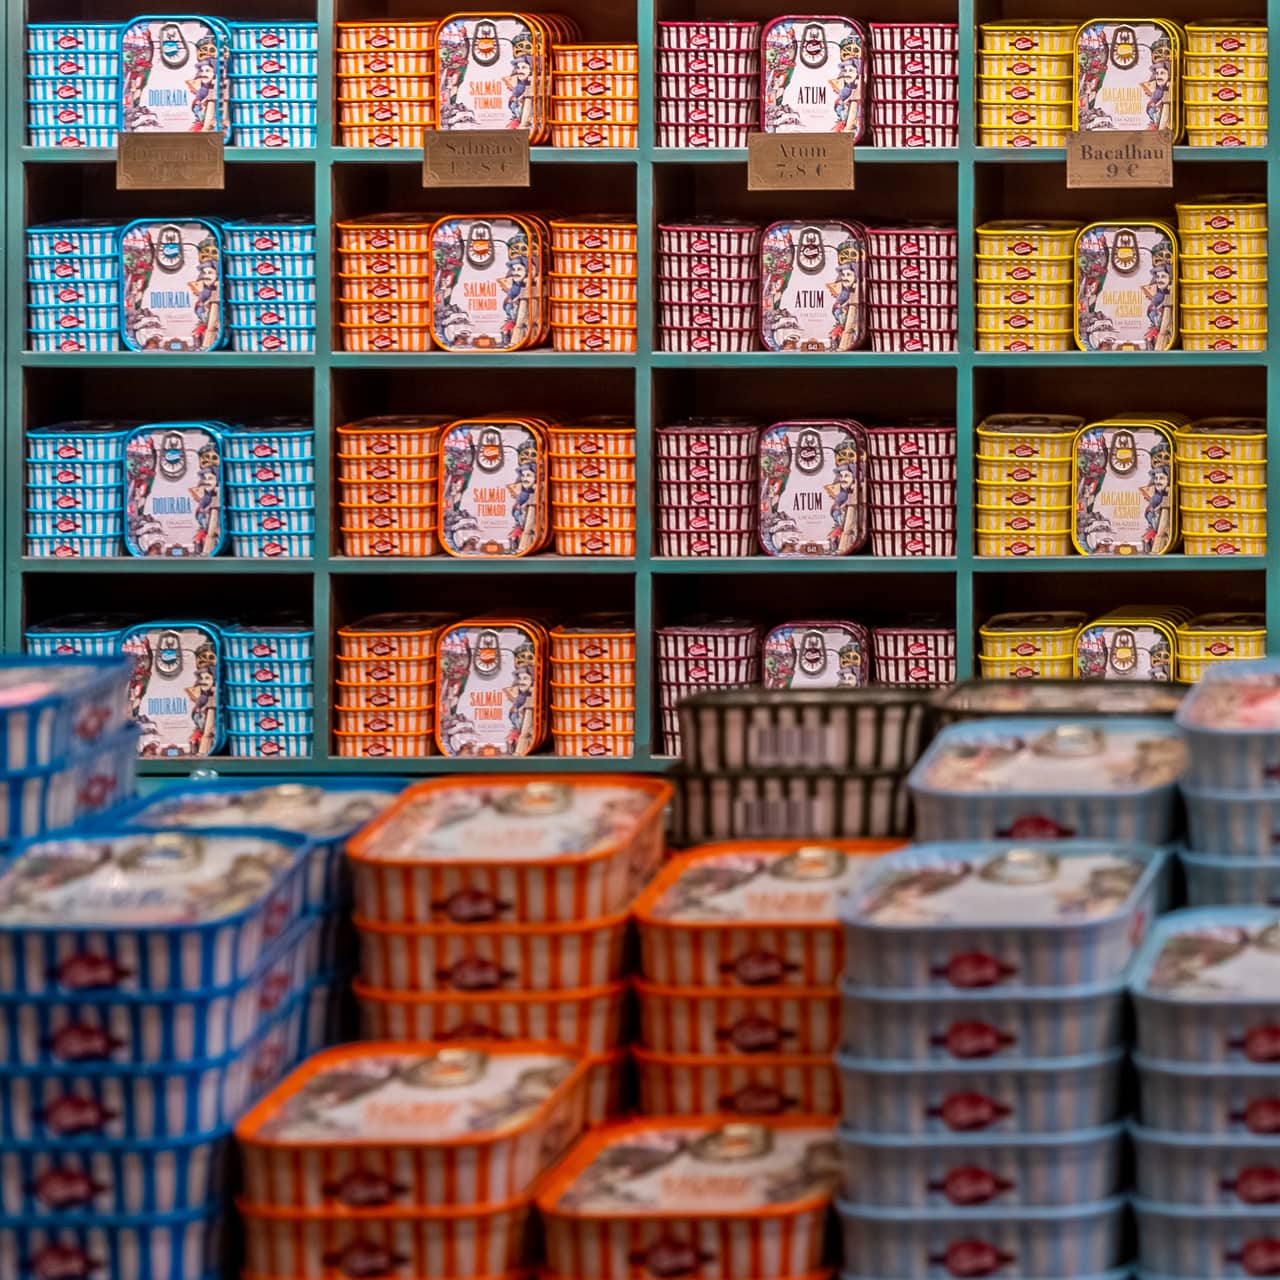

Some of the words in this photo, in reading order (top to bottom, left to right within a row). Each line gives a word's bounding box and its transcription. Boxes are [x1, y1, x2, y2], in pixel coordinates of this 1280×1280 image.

[469, 81, 502, 96] SALMÃO
[797, 86, 826, 105] ATUM
[149, 89, 188, 107] DOURADA
[474, 97, 502, 109] FUMADO
[779, 144, 826, 158] Atum
[1081, 145, 1164, 160] Bacalhau
[777, 164, 806, 178] 7,8
[1107, 163, 1118, 178] 9
[1127, 163, 1138, 177] €
[464, 281, 497, 297] SALMÃO
[151, 291, 190, 309] DOURADA
[468, 298, 497, 311] FUMADO
[795, 290, 824, 308] ATUM
[473, 487, 505, 503] SALMÃO
[793, 492, 822, 511] ATUM
[152, 498, 192, 515] DOURADA
[478, 504, 506, 516] FUMADO
[149, 697, 188, 715] DOURADA
[470, 692, 502, 707] SALMÃO
[475, 708, 502, 720] FUMADO
